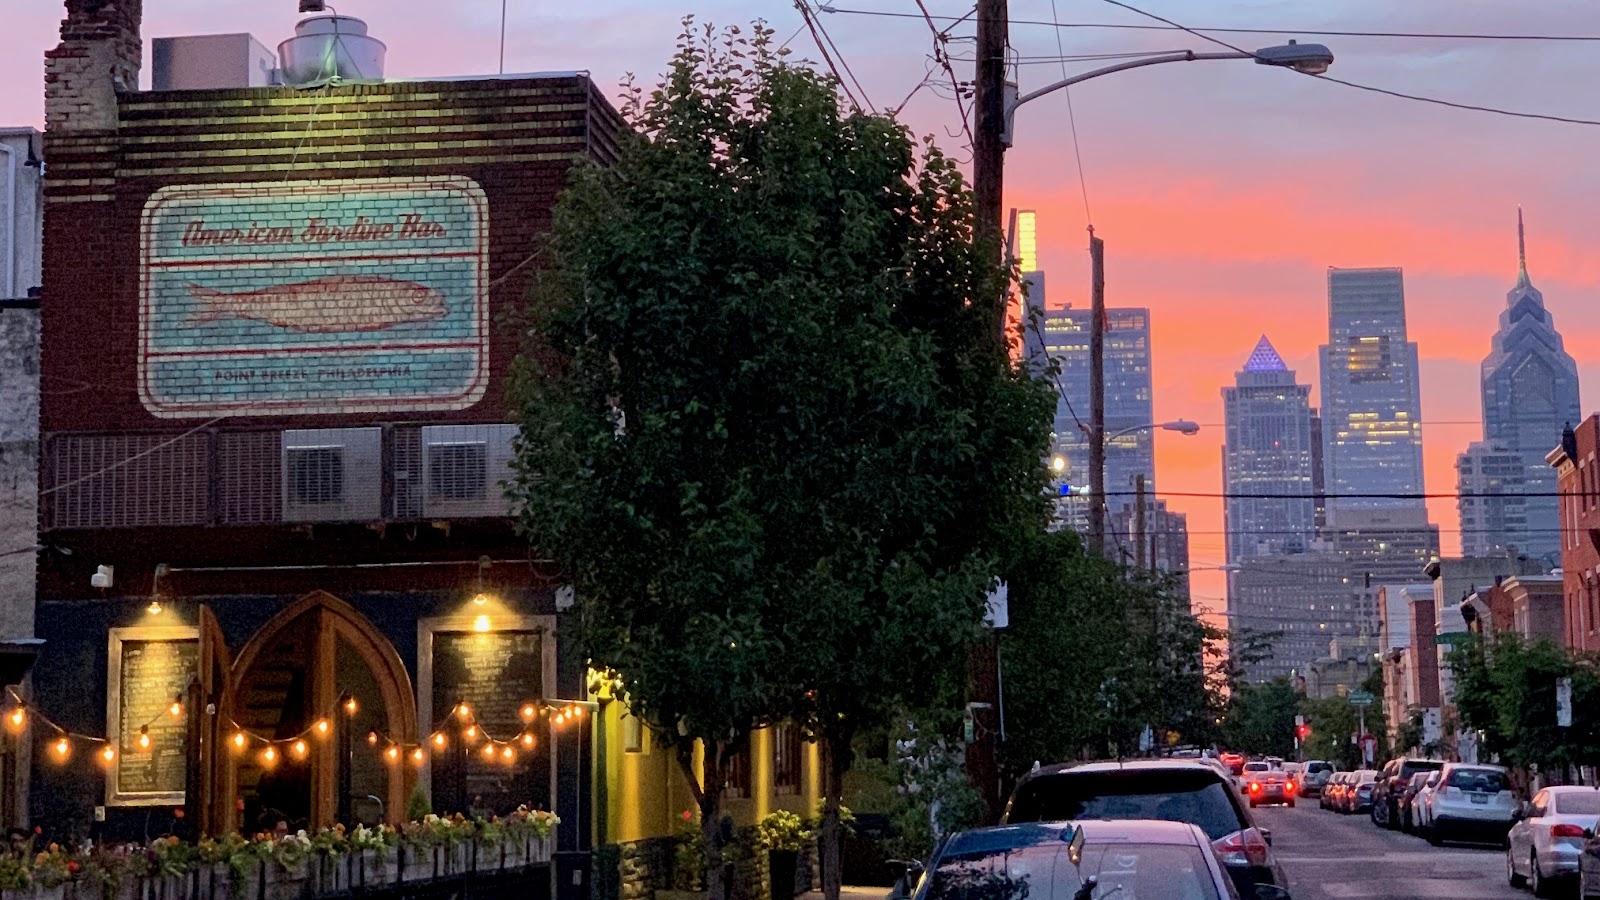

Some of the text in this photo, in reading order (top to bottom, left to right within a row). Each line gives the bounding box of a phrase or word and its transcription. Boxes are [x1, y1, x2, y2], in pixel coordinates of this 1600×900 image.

[181, 213, 447, 246] American Sardine Bar
[215, 369, 255, 381] POINT
[317, 366, 412, 379] PHILADELPHIA
